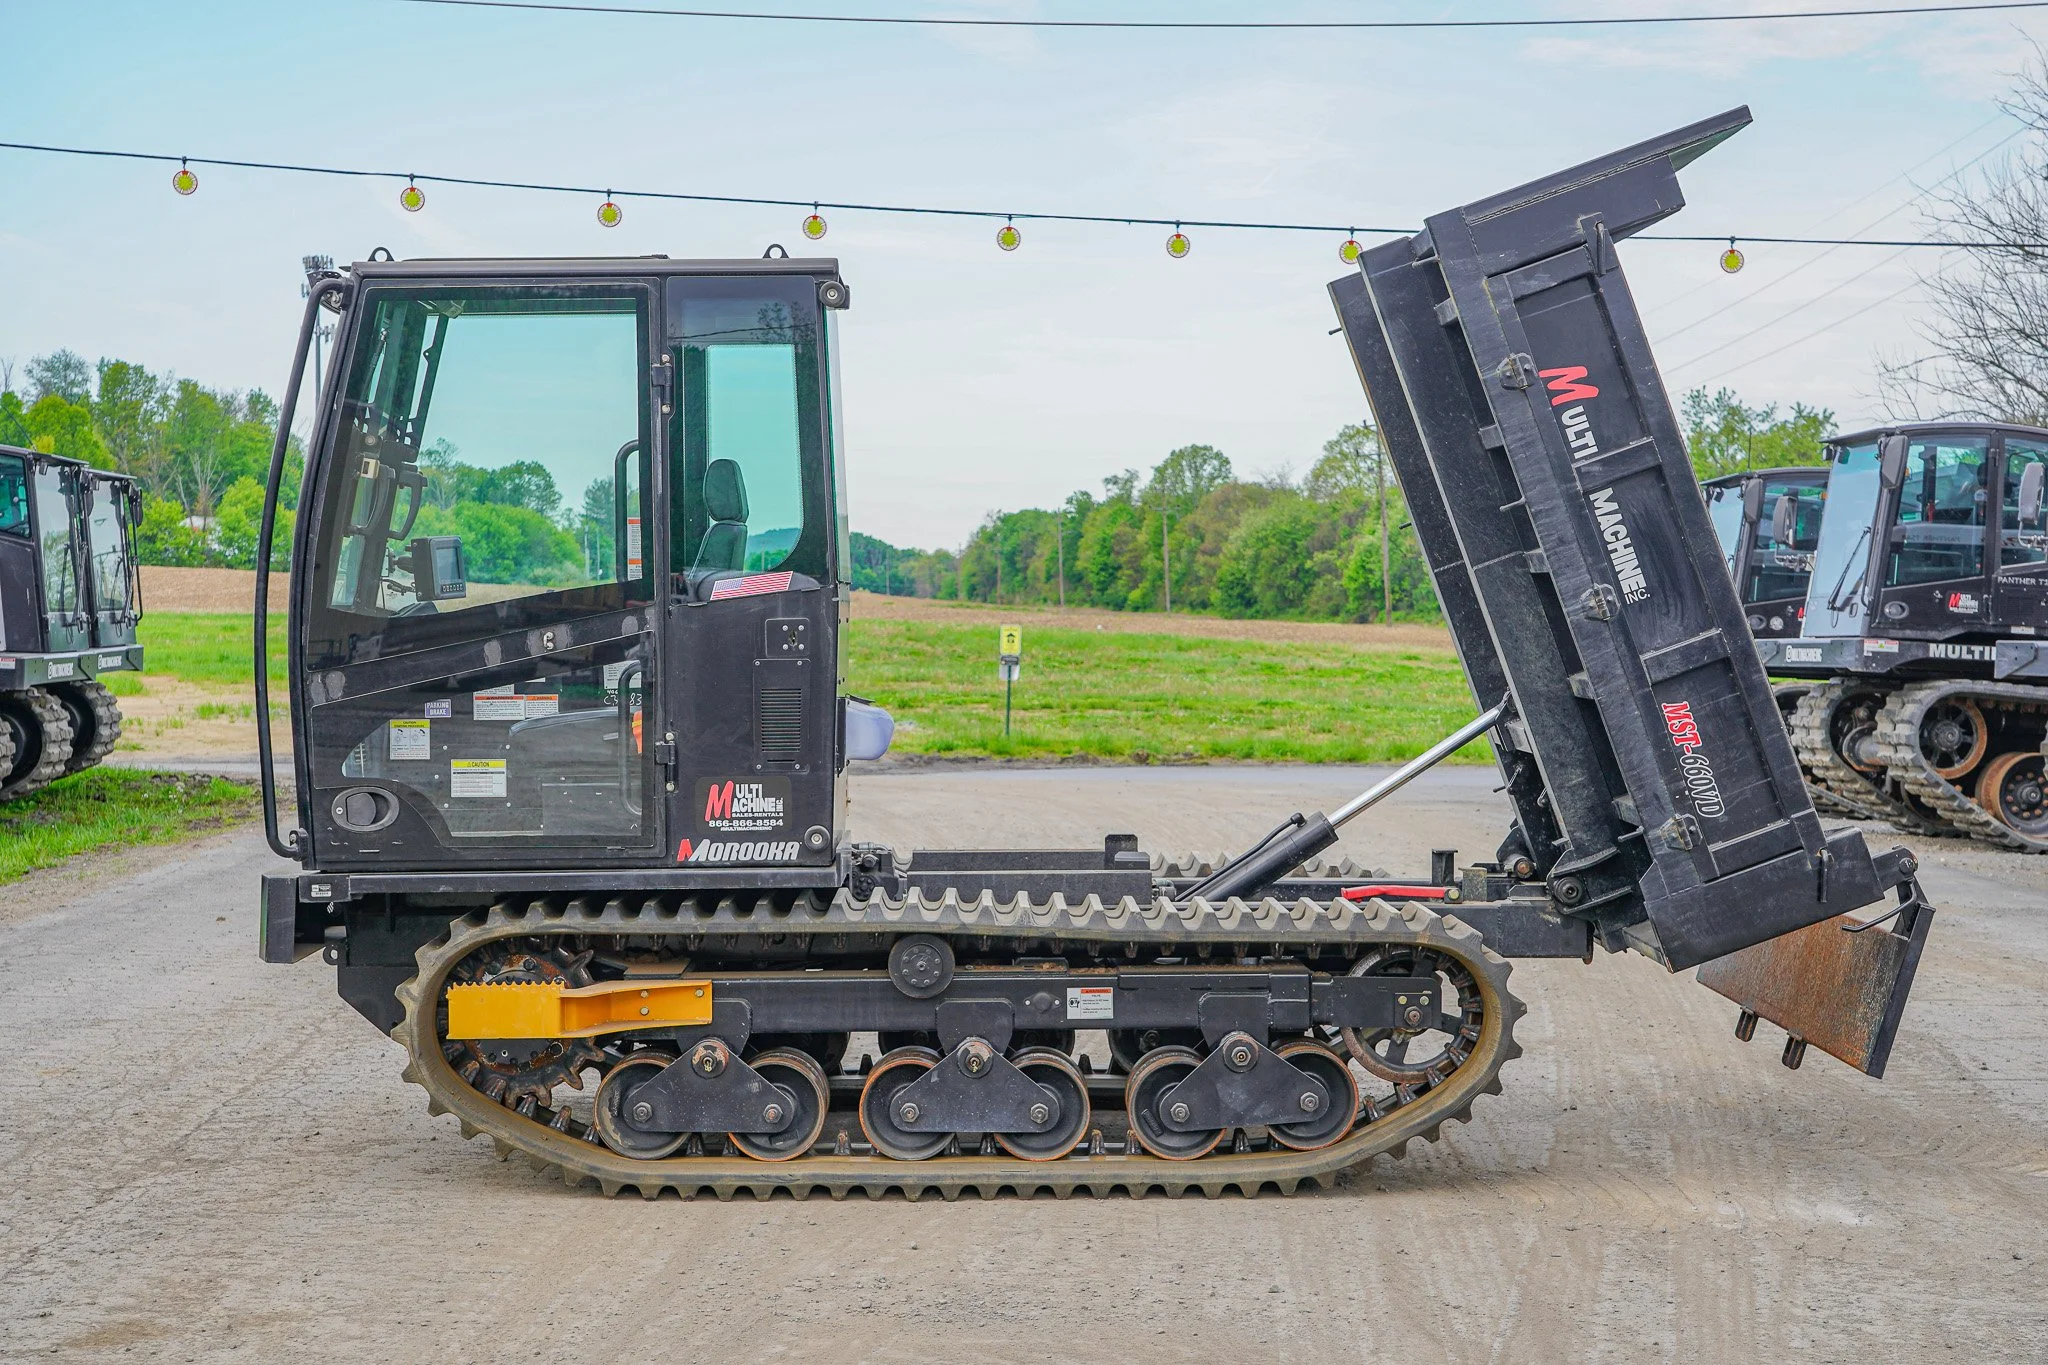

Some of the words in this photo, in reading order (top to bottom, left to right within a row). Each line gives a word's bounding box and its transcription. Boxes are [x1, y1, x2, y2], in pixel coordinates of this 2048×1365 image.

[1588, 487, 1647, 594] MACHINE
[1624, 588, 1651, 605] INC.
[1997, 576, 2036, 585] PANTHER
[426, 701, 449, 709] PARKING
[1661, 701, 1725, 818] MST-660VD
[708, 819, 784, 828] 866-866-8584
[677, 838, 800, 862] MOROOKA
